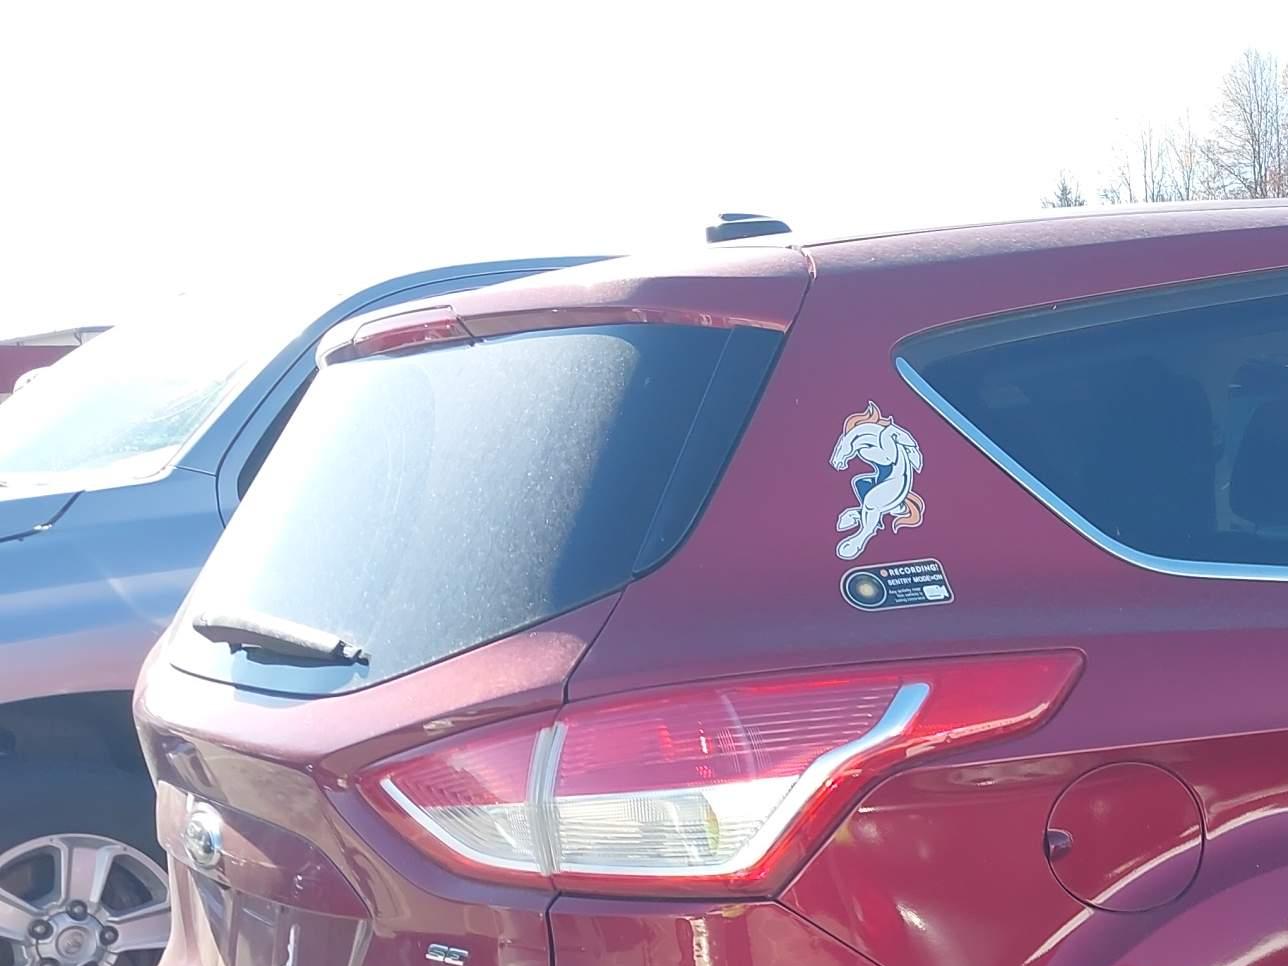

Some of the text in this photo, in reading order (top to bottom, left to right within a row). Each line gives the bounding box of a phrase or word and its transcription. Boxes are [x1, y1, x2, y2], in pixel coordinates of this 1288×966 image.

[888, 564, 938, 577] RECORDING!
[887, 576, 912, 586] SENTRY
[425, 943, 469, 966] SE
